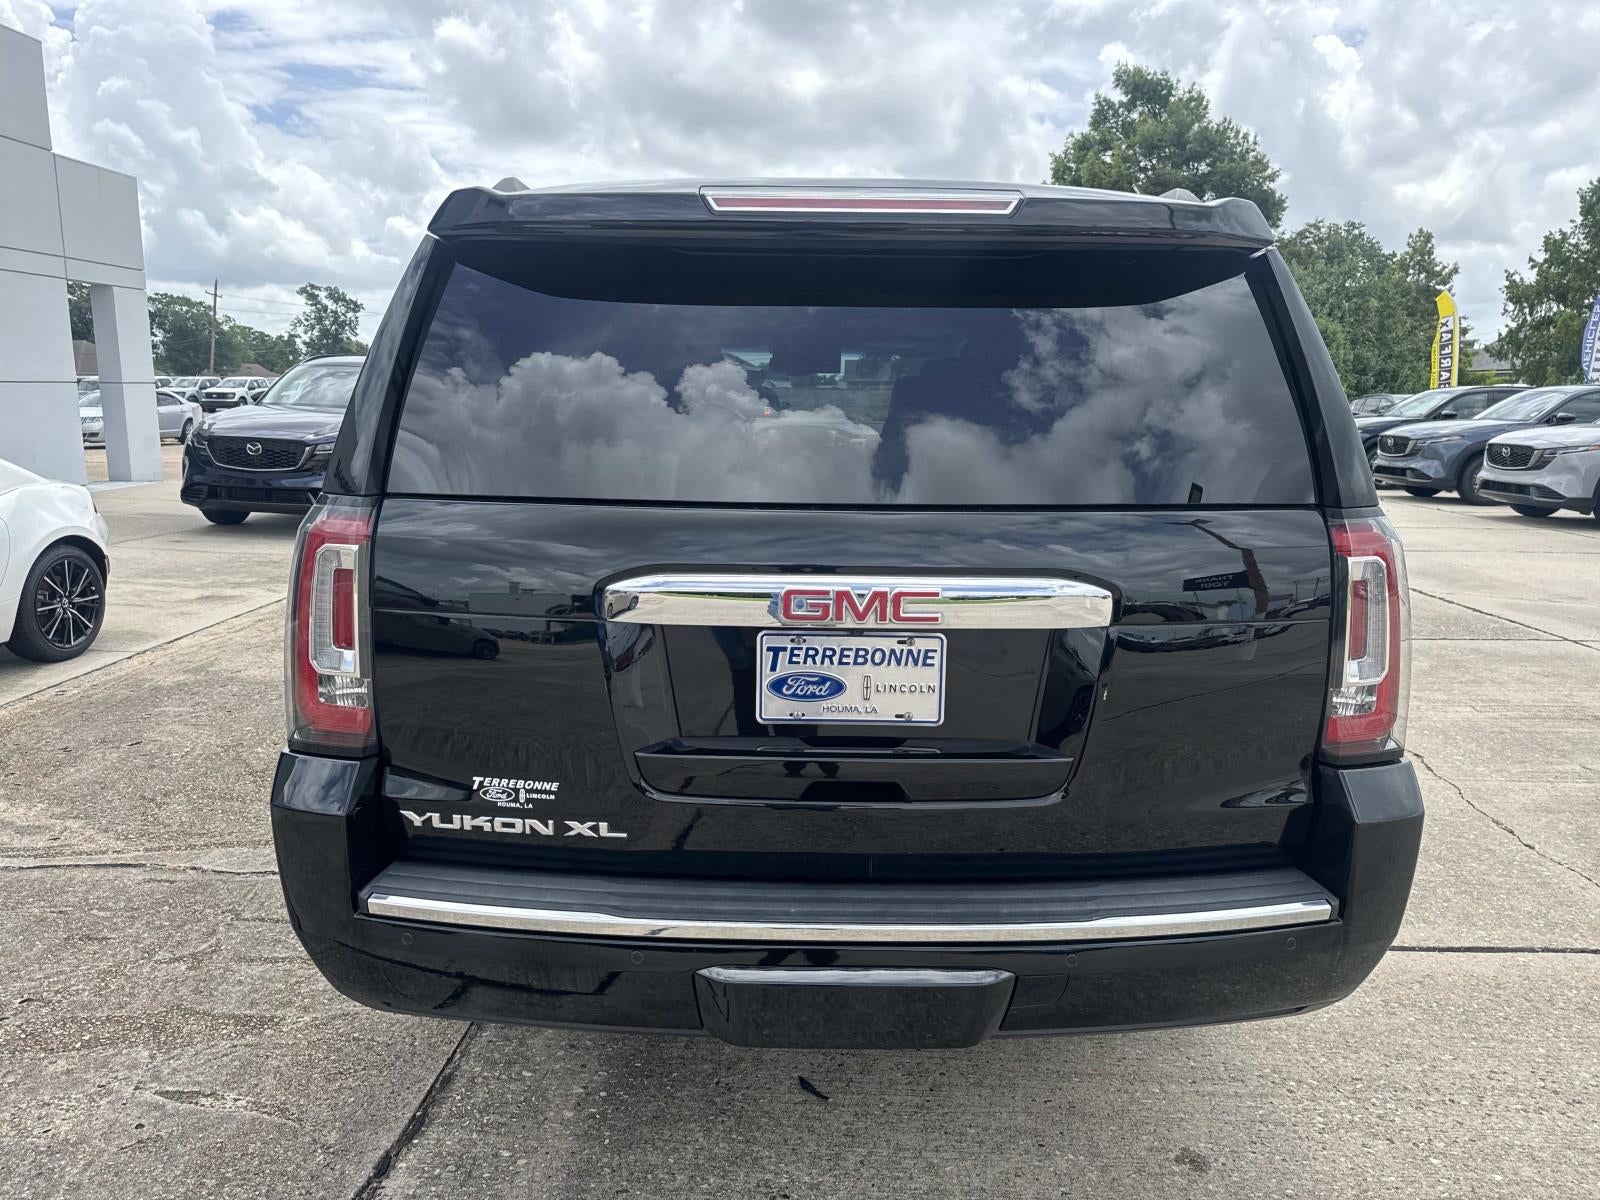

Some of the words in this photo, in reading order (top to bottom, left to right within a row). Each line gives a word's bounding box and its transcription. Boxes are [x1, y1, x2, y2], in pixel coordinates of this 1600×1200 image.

[781, 587, 942, 624] GMC
[765, 645, 938, 672] TERREBONNE
[782, 675, 830, 697] Ford
[876, 684, 936, 694] LINCOLN
[822, 705, 861, 714] HOUMA,
[865, 705, 878, 714] LA
[472, 776, 560, 791] TERREBONNE
[486, 788, 508, 799] Ford
[497, 801, 523, 809] HOUMA,
[400, 810, 555, 836] YUKON
[563, 821, 628, 838] XL
